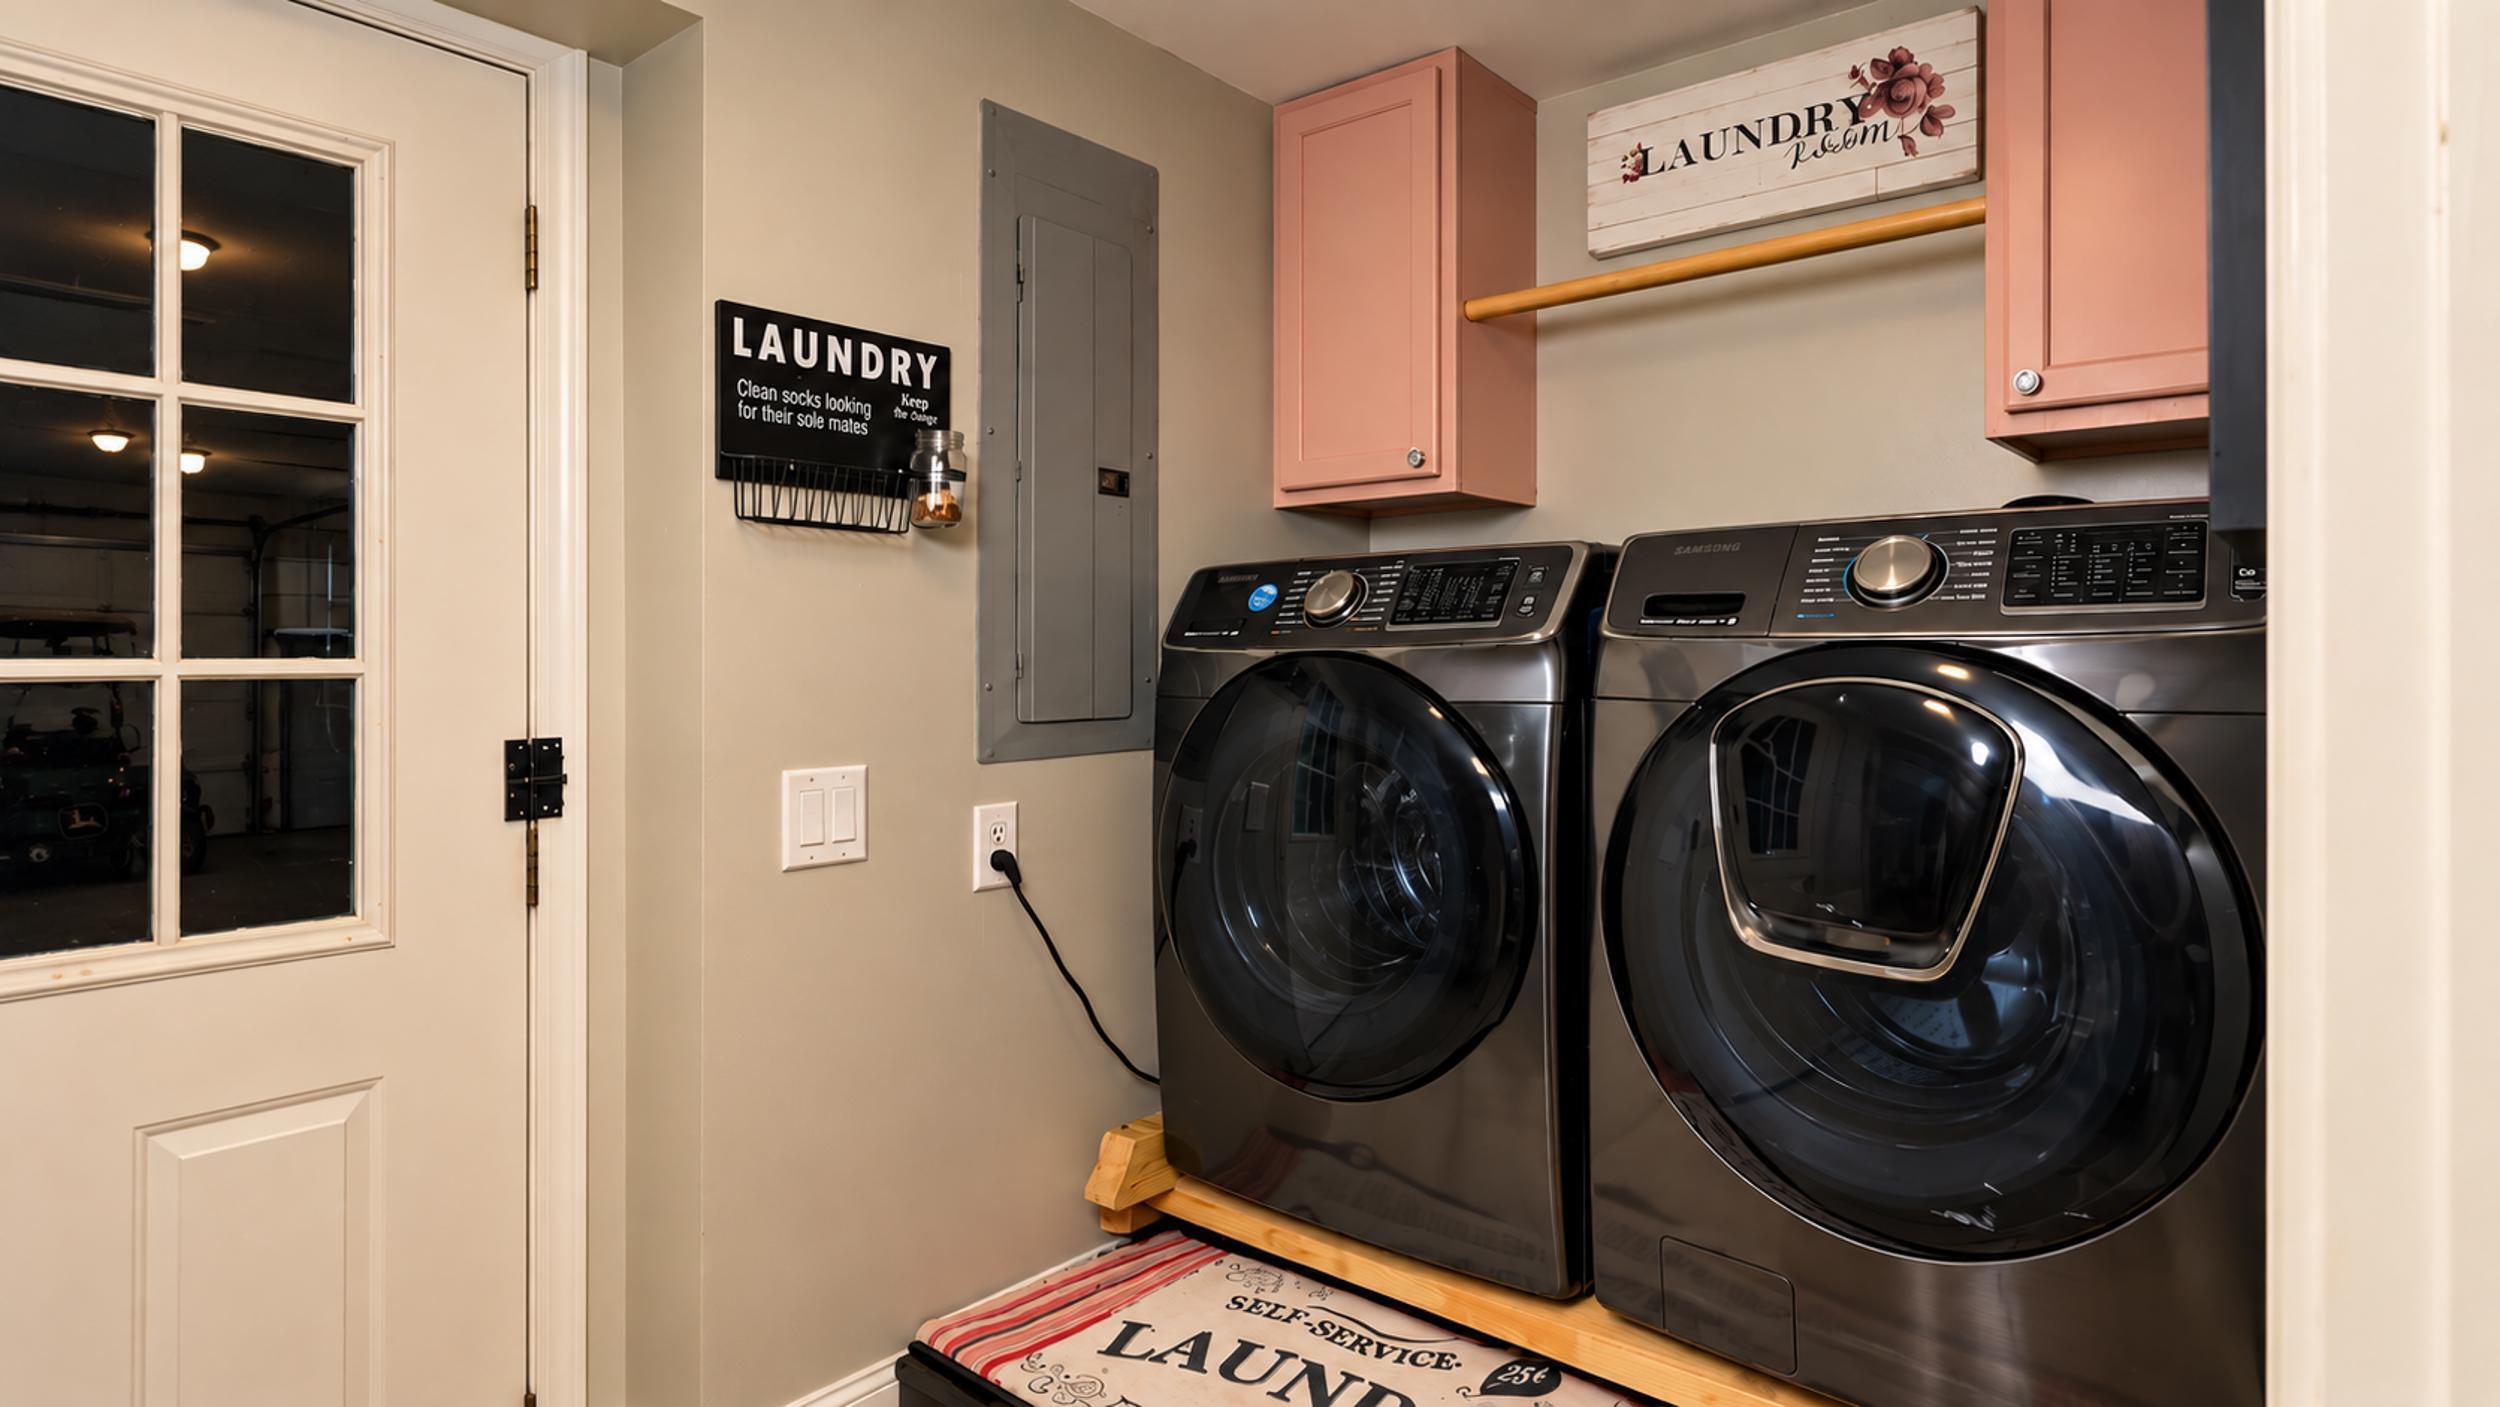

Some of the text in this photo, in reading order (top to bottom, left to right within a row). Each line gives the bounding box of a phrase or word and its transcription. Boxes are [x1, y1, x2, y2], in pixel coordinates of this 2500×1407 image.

[1638, 93, 1872, 177] LAUNDRY
[1783, 119, 1900, 169] Room
[733, 316, 938, 390] LAUNDRY
[736, 377, 872, 421] Clean socks looking
[737, 400, 869, 436] for their sole mates
[900, 393, 930, 413] Keep
[1224, 1294, 1458, 1371] SELF-SERVICE
